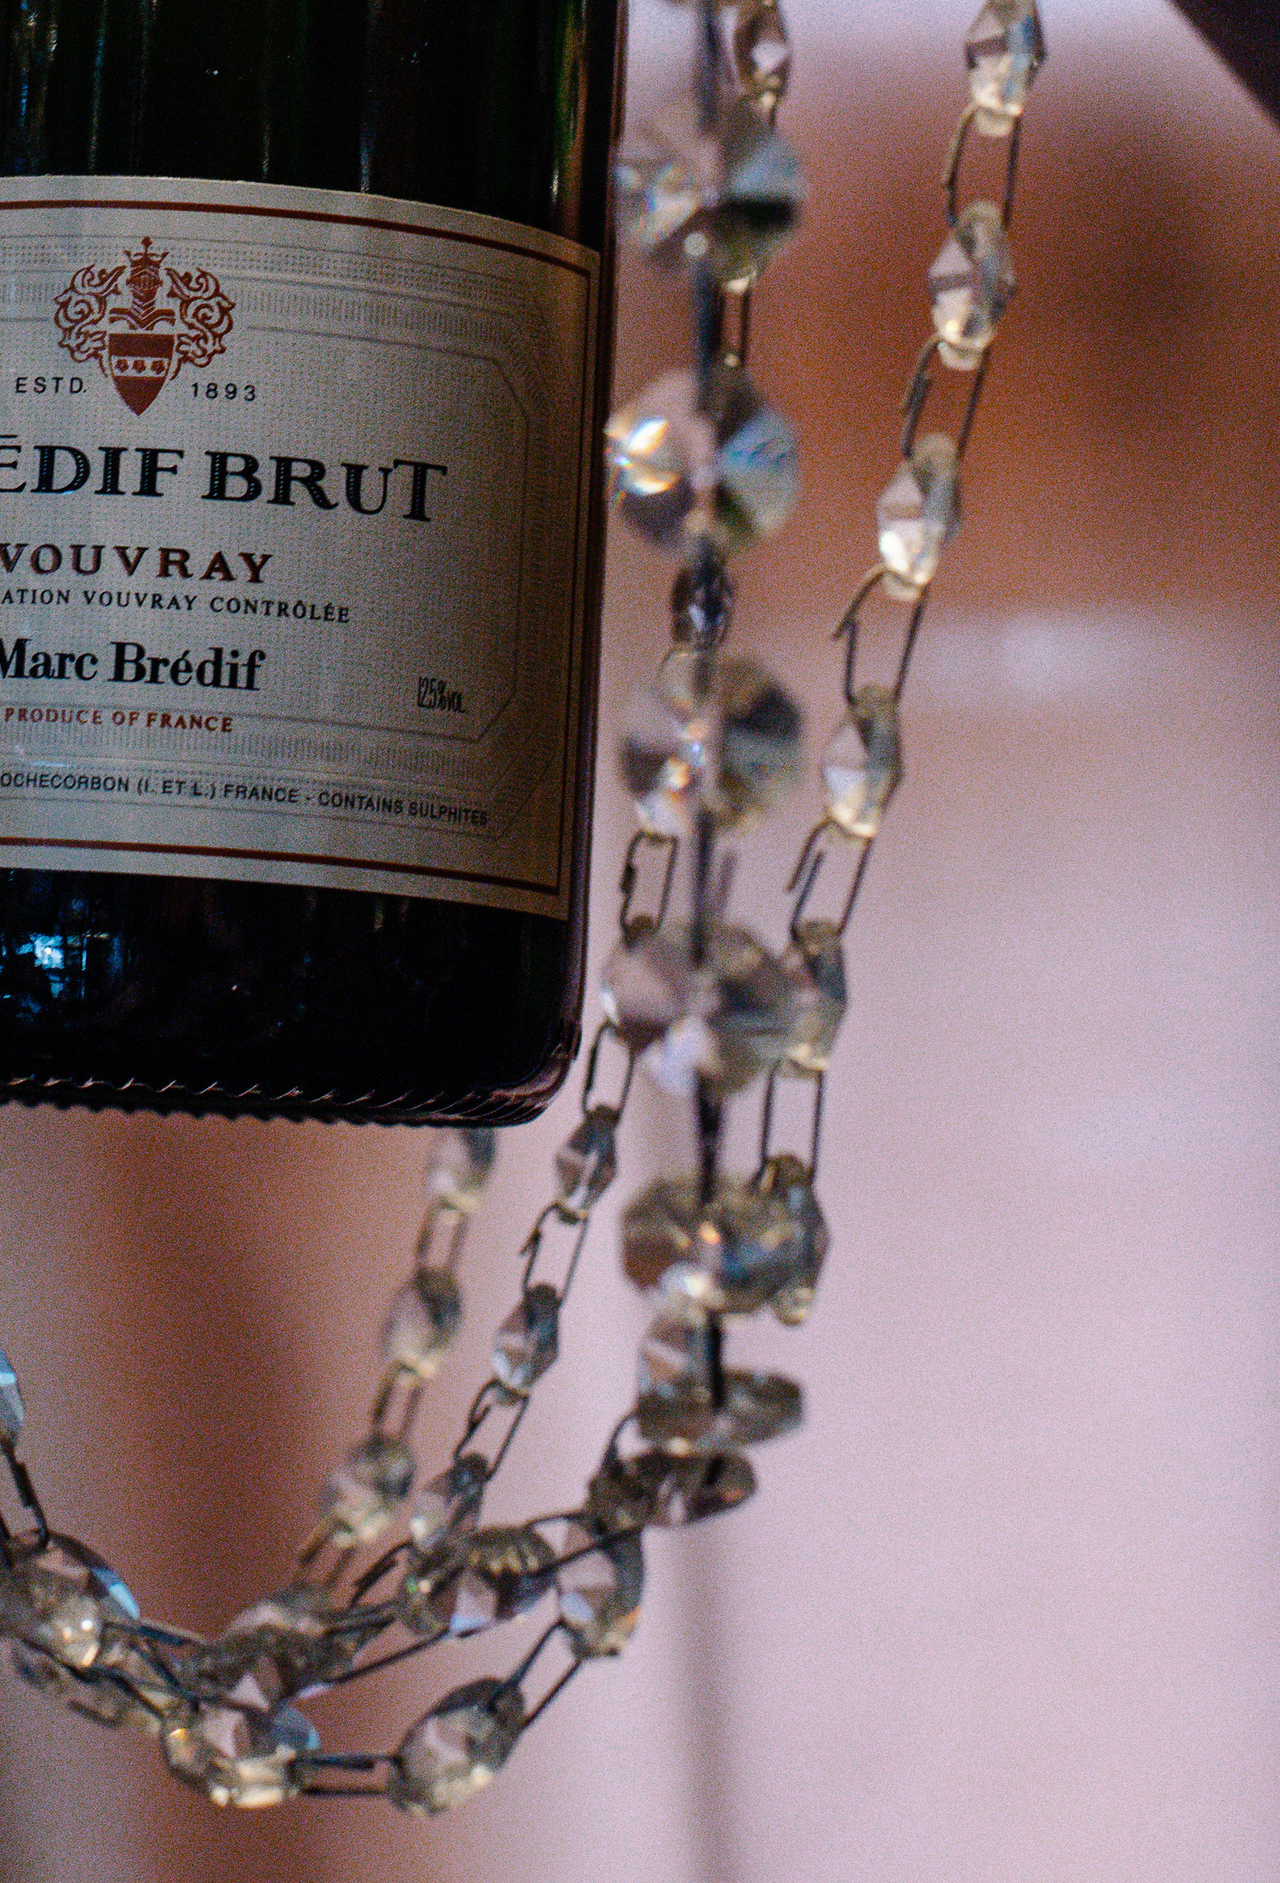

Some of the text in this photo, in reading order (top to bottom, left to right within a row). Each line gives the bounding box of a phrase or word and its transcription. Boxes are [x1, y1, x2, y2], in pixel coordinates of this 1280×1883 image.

[192, 382, 257, 402] 1893
[201, 450, 449, 523] BRUT
[82, 590, 199, 612] VOUVRAY
[108, 641, 266, 691] Brédif
[4, 707, 233, 733] PRODUCE OF FRANCE
[162, 780, 187, 795] ET
[223, 784, 300, 804] FRANCE
[318, 791, 404, 815] CONTAINS
[408, 802, 488, 826] SULPHITES
